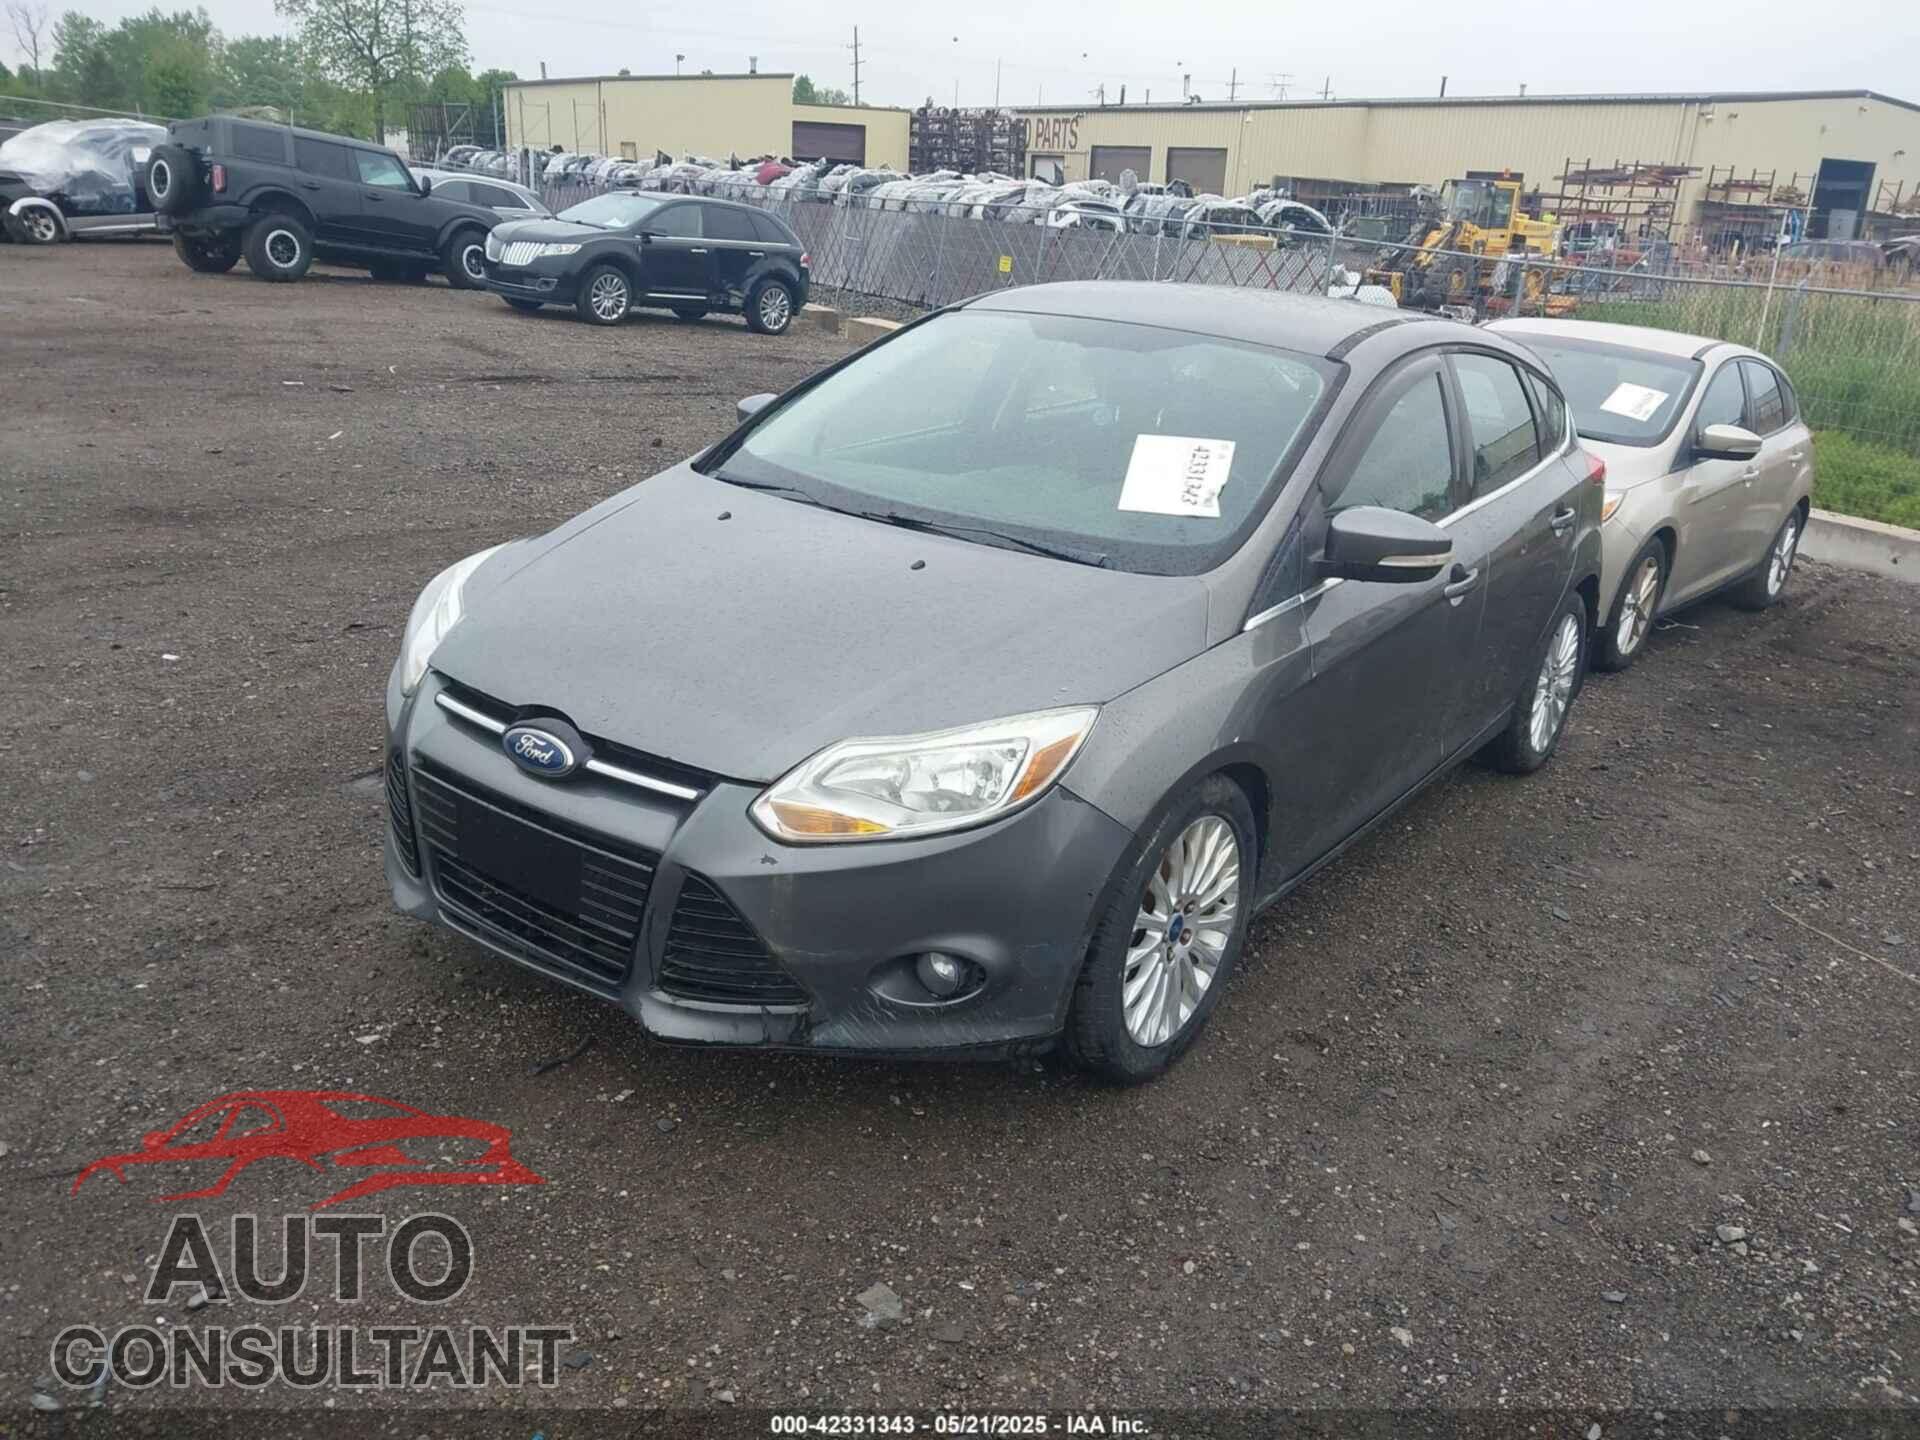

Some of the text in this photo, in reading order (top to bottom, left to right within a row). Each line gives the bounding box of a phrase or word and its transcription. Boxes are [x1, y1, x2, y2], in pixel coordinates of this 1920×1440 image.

[1035, 118, 1079, 150] PARTS
[1181, 445, 1211, 506] 42331343
[514, 733, 555, 765] Ford
